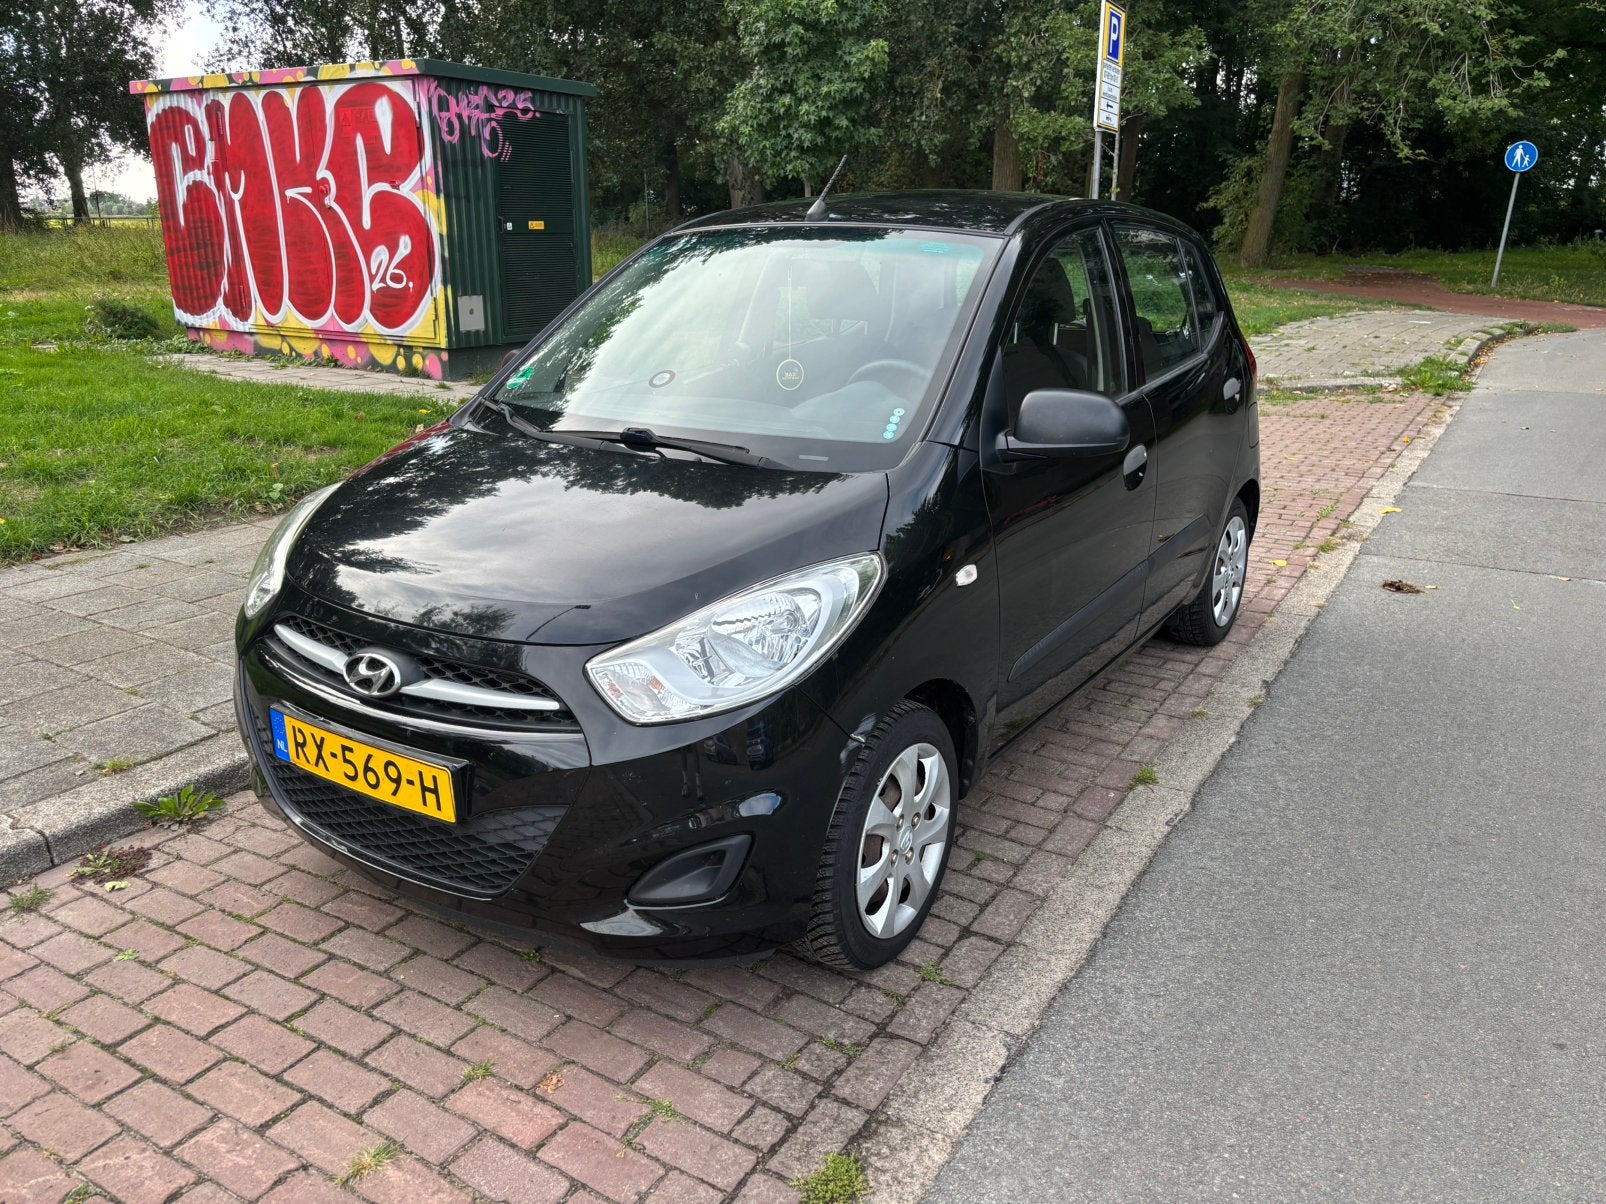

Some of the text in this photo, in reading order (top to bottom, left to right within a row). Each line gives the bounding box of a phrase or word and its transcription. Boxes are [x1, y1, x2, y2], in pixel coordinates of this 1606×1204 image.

[1109, 15, 1119, 54] P
[276, 739, 288, 753] NL
[291, 725, 442, 812] RX-569-H
